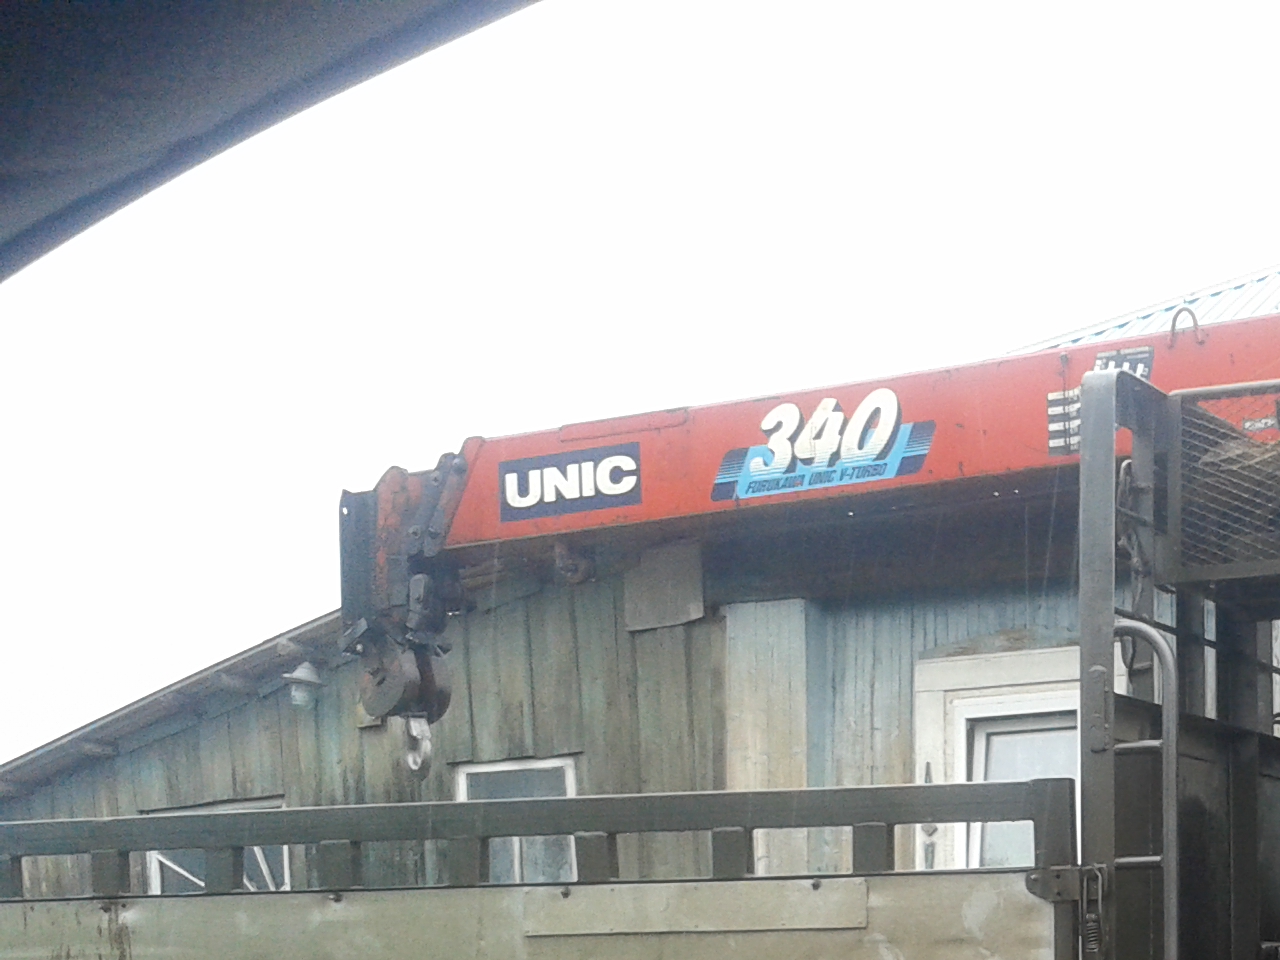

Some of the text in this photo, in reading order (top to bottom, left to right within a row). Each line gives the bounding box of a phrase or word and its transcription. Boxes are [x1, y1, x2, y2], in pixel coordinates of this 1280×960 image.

[749, 388, 899, 474] 340
[505, 455, 637, 508] UNIC
[745, 463, 888, 494] FURUKAWA UNIC V-TURBO
